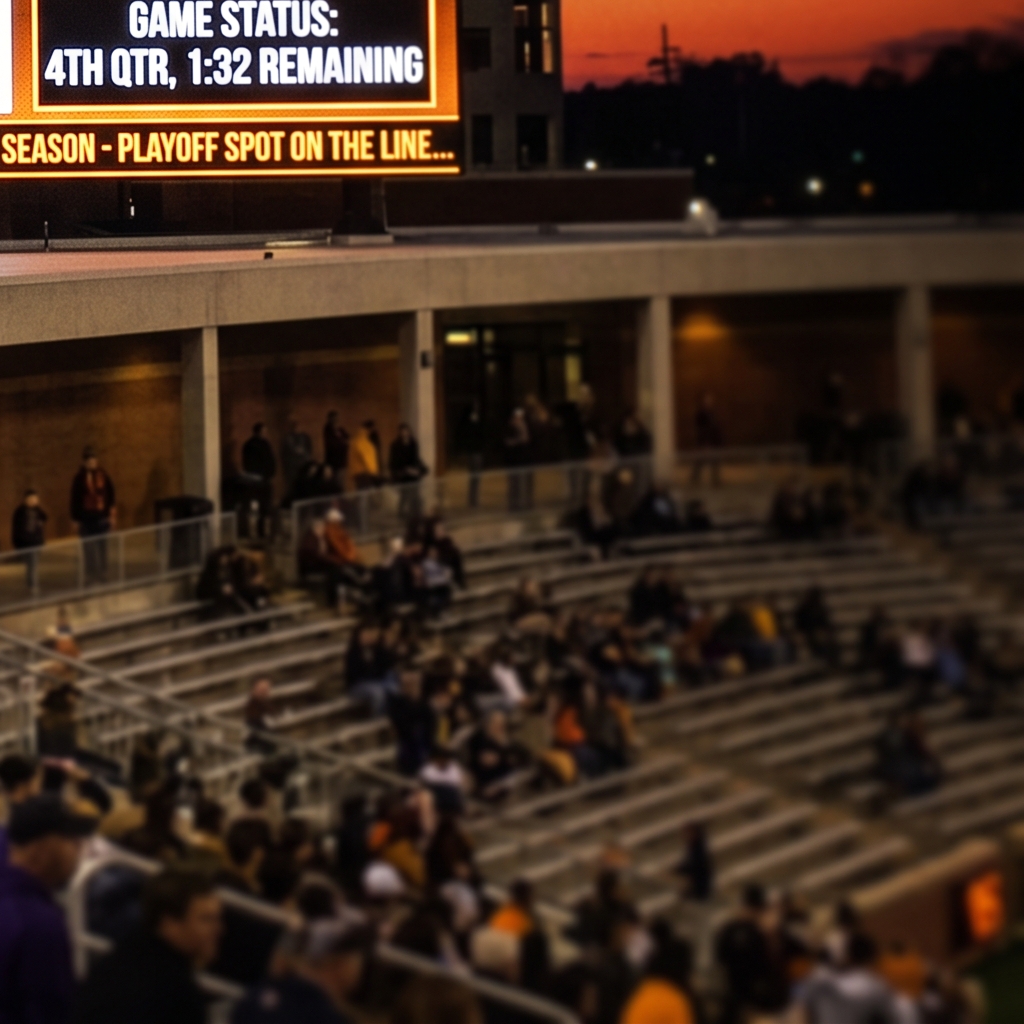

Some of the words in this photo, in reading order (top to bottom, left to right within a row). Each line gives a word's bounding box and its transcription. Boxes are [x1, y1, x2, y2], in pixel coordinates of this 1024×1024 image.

[128, 1, 214, 39] GAME
[219, 0, 339, 38] STATUS:
[44, 49, 104, 86] 4TH
[110, 49, 177, 90] QTR,
[187, 48, 252, 85] 1:32
[259, 46, 424, 84] REMAINING
[1, 132, 96, 165] SEASON
[117, 132, 220, 163] PLAYOFF
[224, 131, 285, 162] SPOT
[289, 131, 324, 162] ON
[327, 130, 375, 161] THE
